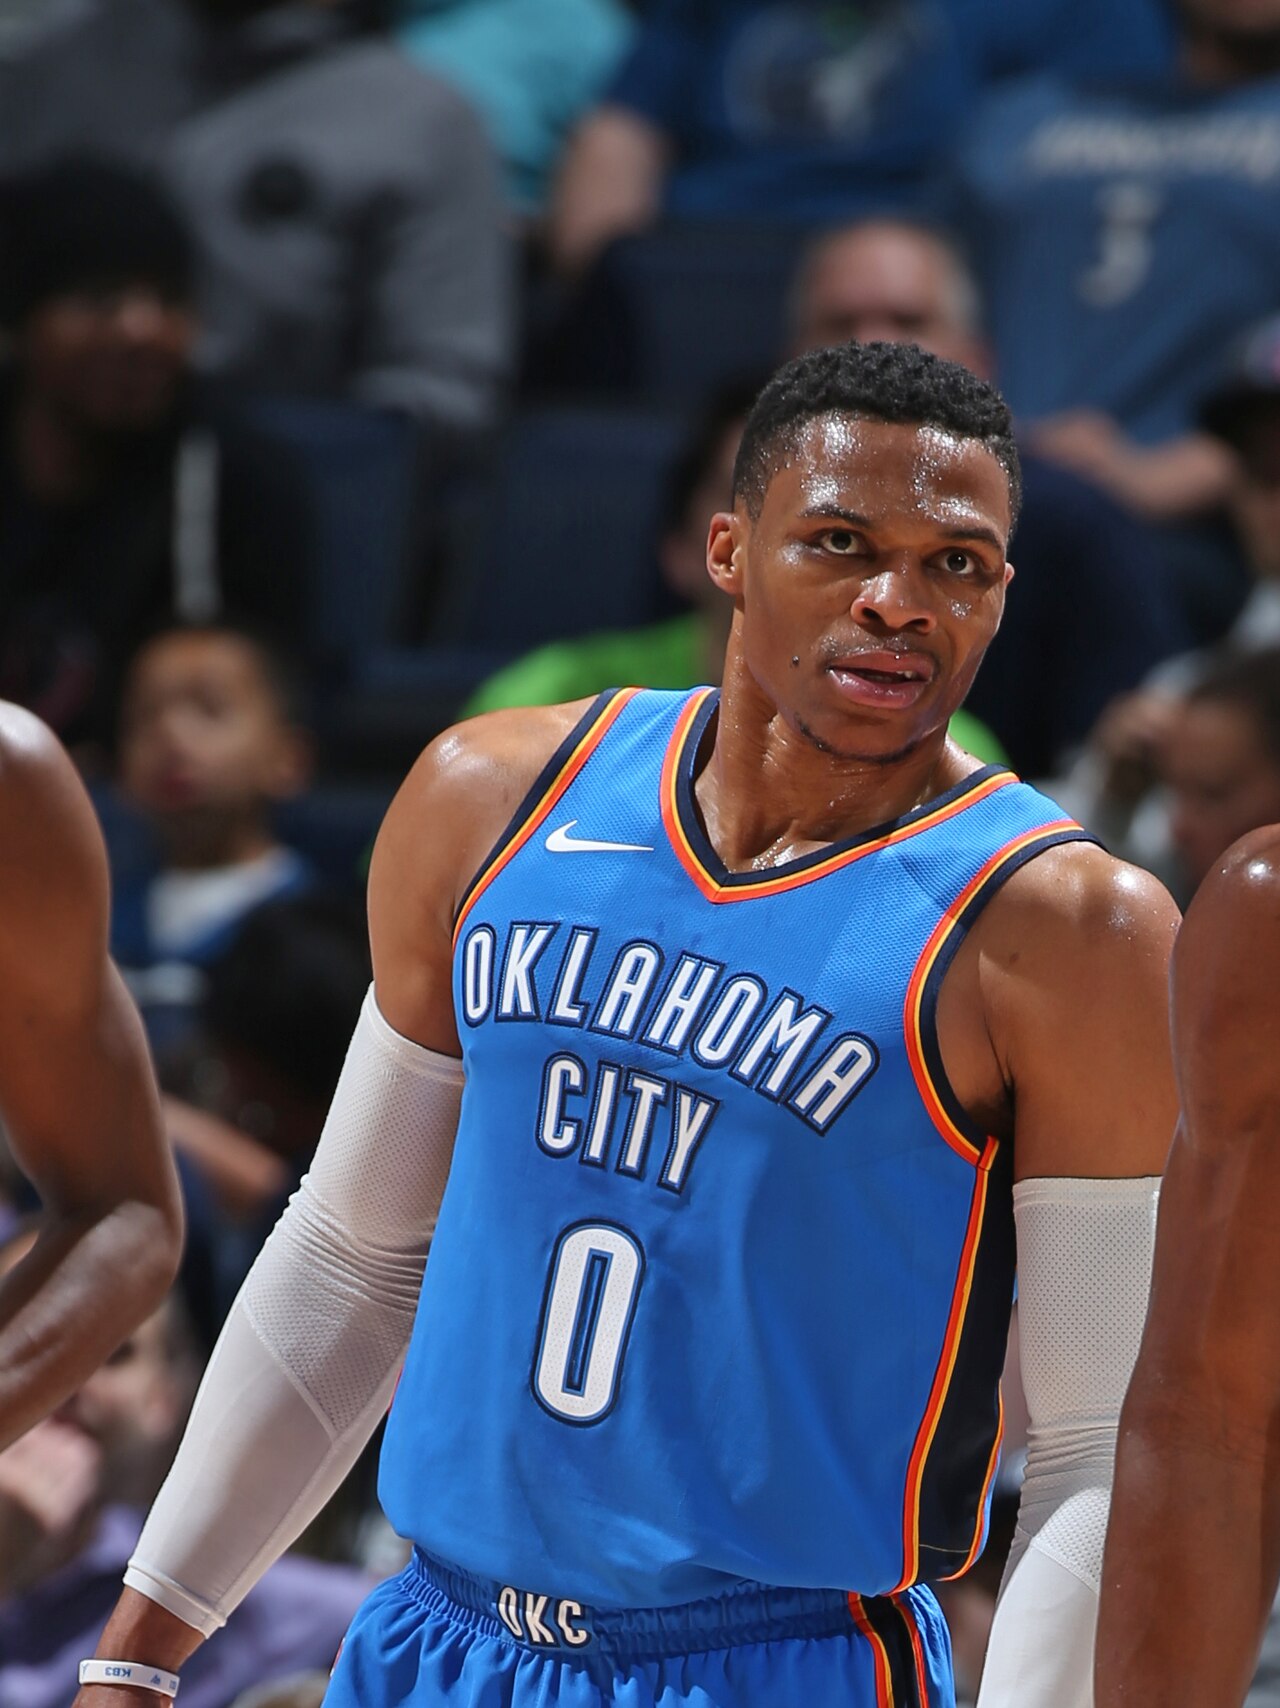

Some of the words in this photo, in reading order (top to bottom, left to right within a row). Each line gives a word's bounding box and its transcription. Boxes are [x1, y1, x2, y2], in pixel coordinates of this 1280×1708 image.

[463, 920, 880, 1136] OKLAHOMA
[535, 1051, 722, 1194] CITY
[530, 1218, 647, 1428] 0
[105, 1666, 132, 1678] KB3
[497, 1585, 592, 1648] OKC
